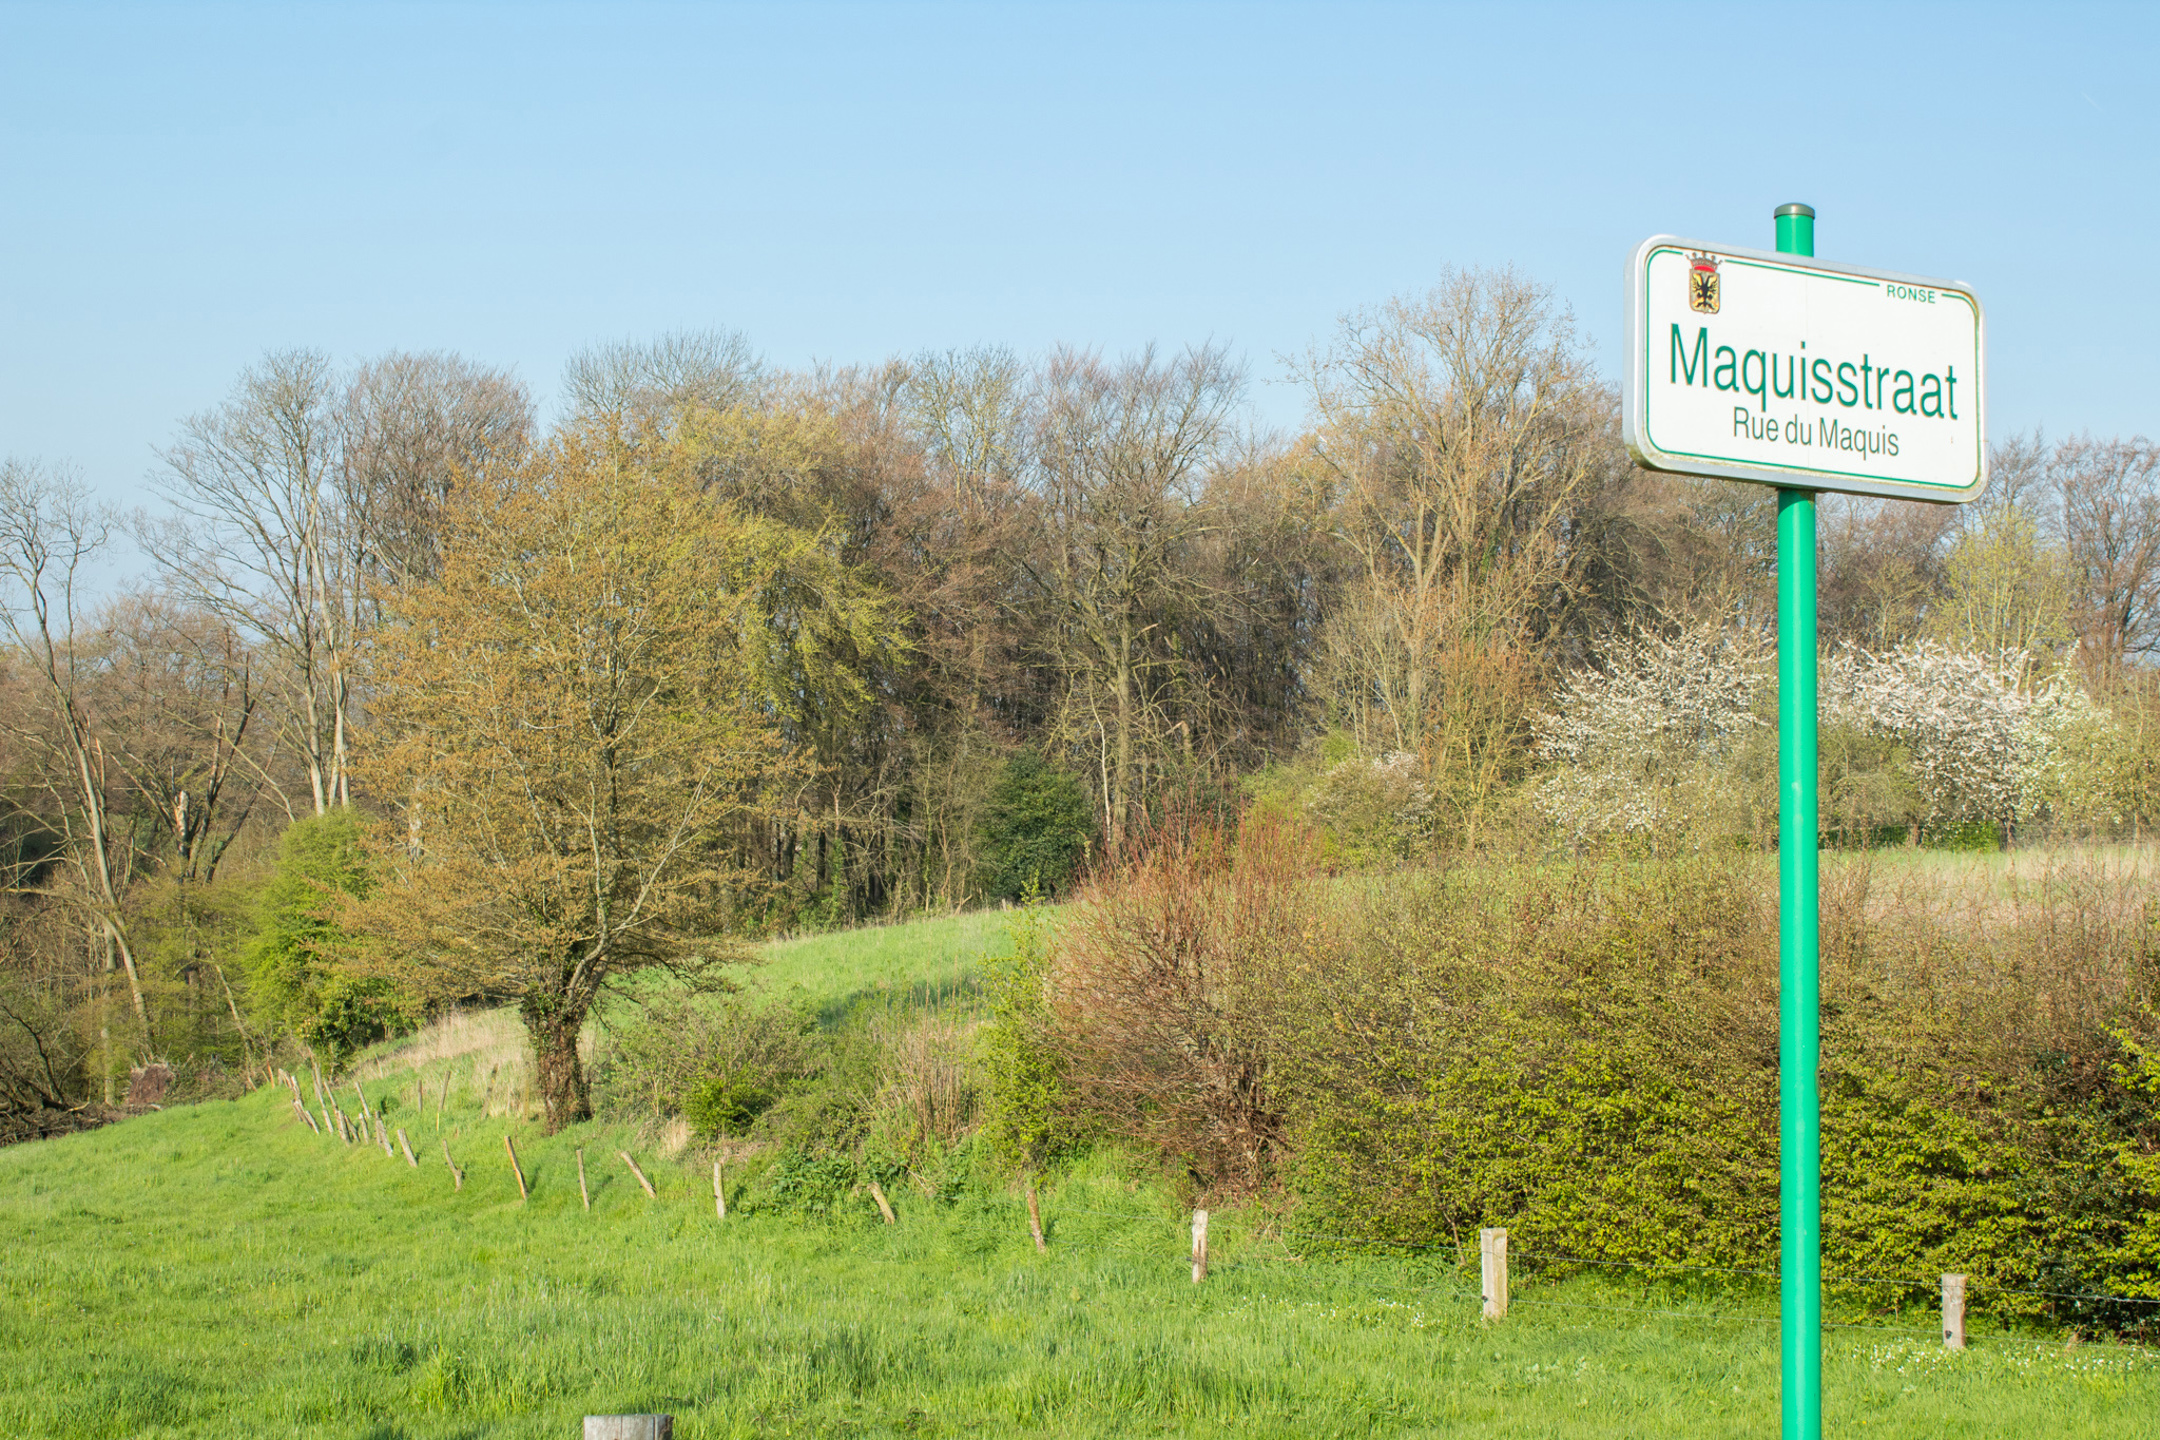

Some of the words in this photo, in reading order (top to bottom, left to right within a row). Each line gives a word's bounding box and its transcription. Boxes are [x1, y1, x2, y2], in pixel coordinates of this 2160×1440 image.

[1886, 284, 1936, 304] RONSE
[1670, 323, 1958, 420] Maquisstraat
[1733, 406, 1779, 442] Rue
[1785, 414, 1812, 446] du
[1819, 417, 1899, 460] Maquis
